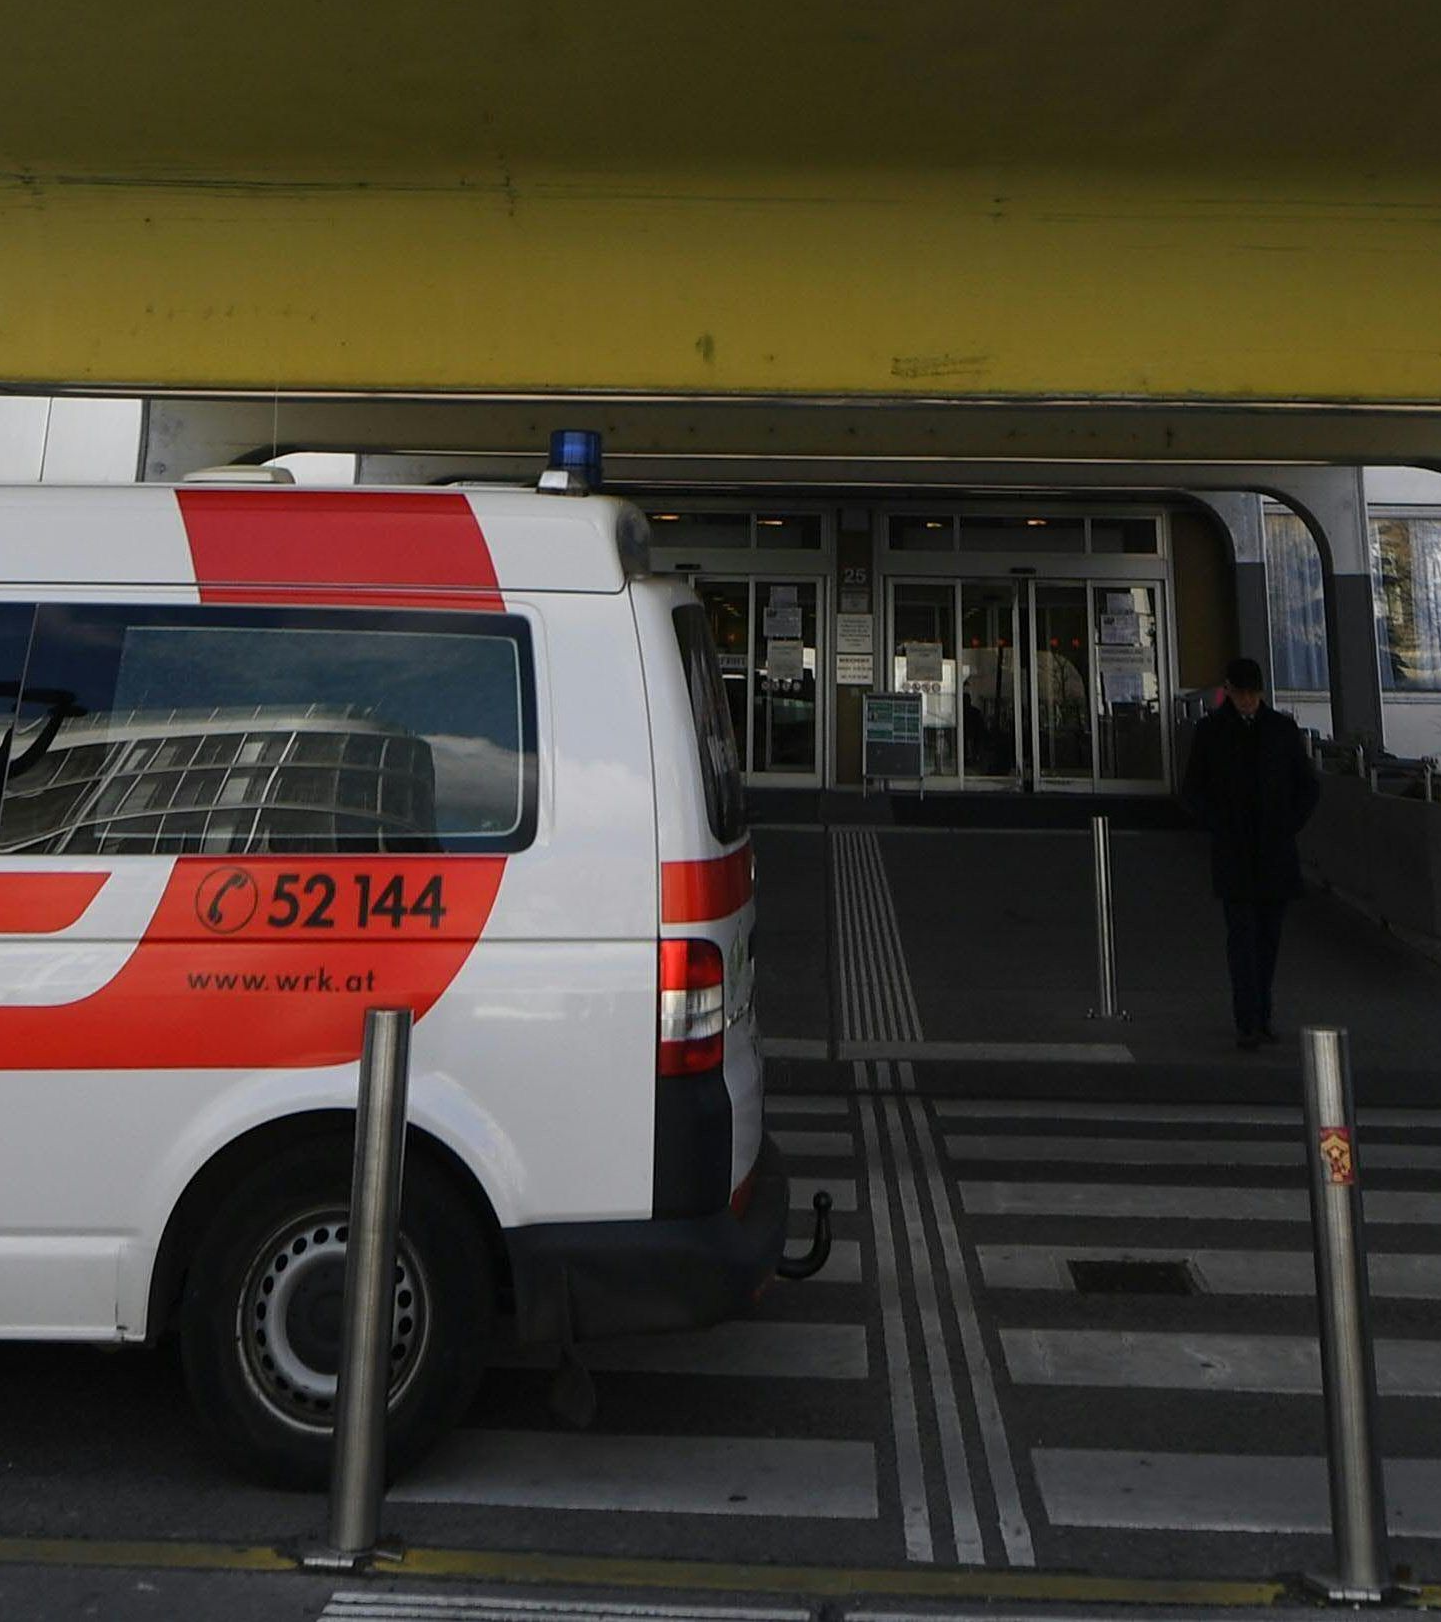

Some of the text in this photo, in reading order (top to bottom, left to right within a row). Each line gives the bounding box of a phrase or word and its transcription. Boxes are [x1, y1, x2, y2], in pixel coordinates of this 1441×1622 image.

[267, 874, 447, 928] 52 144
[187, 967, 376, 992] www.wrk.at
